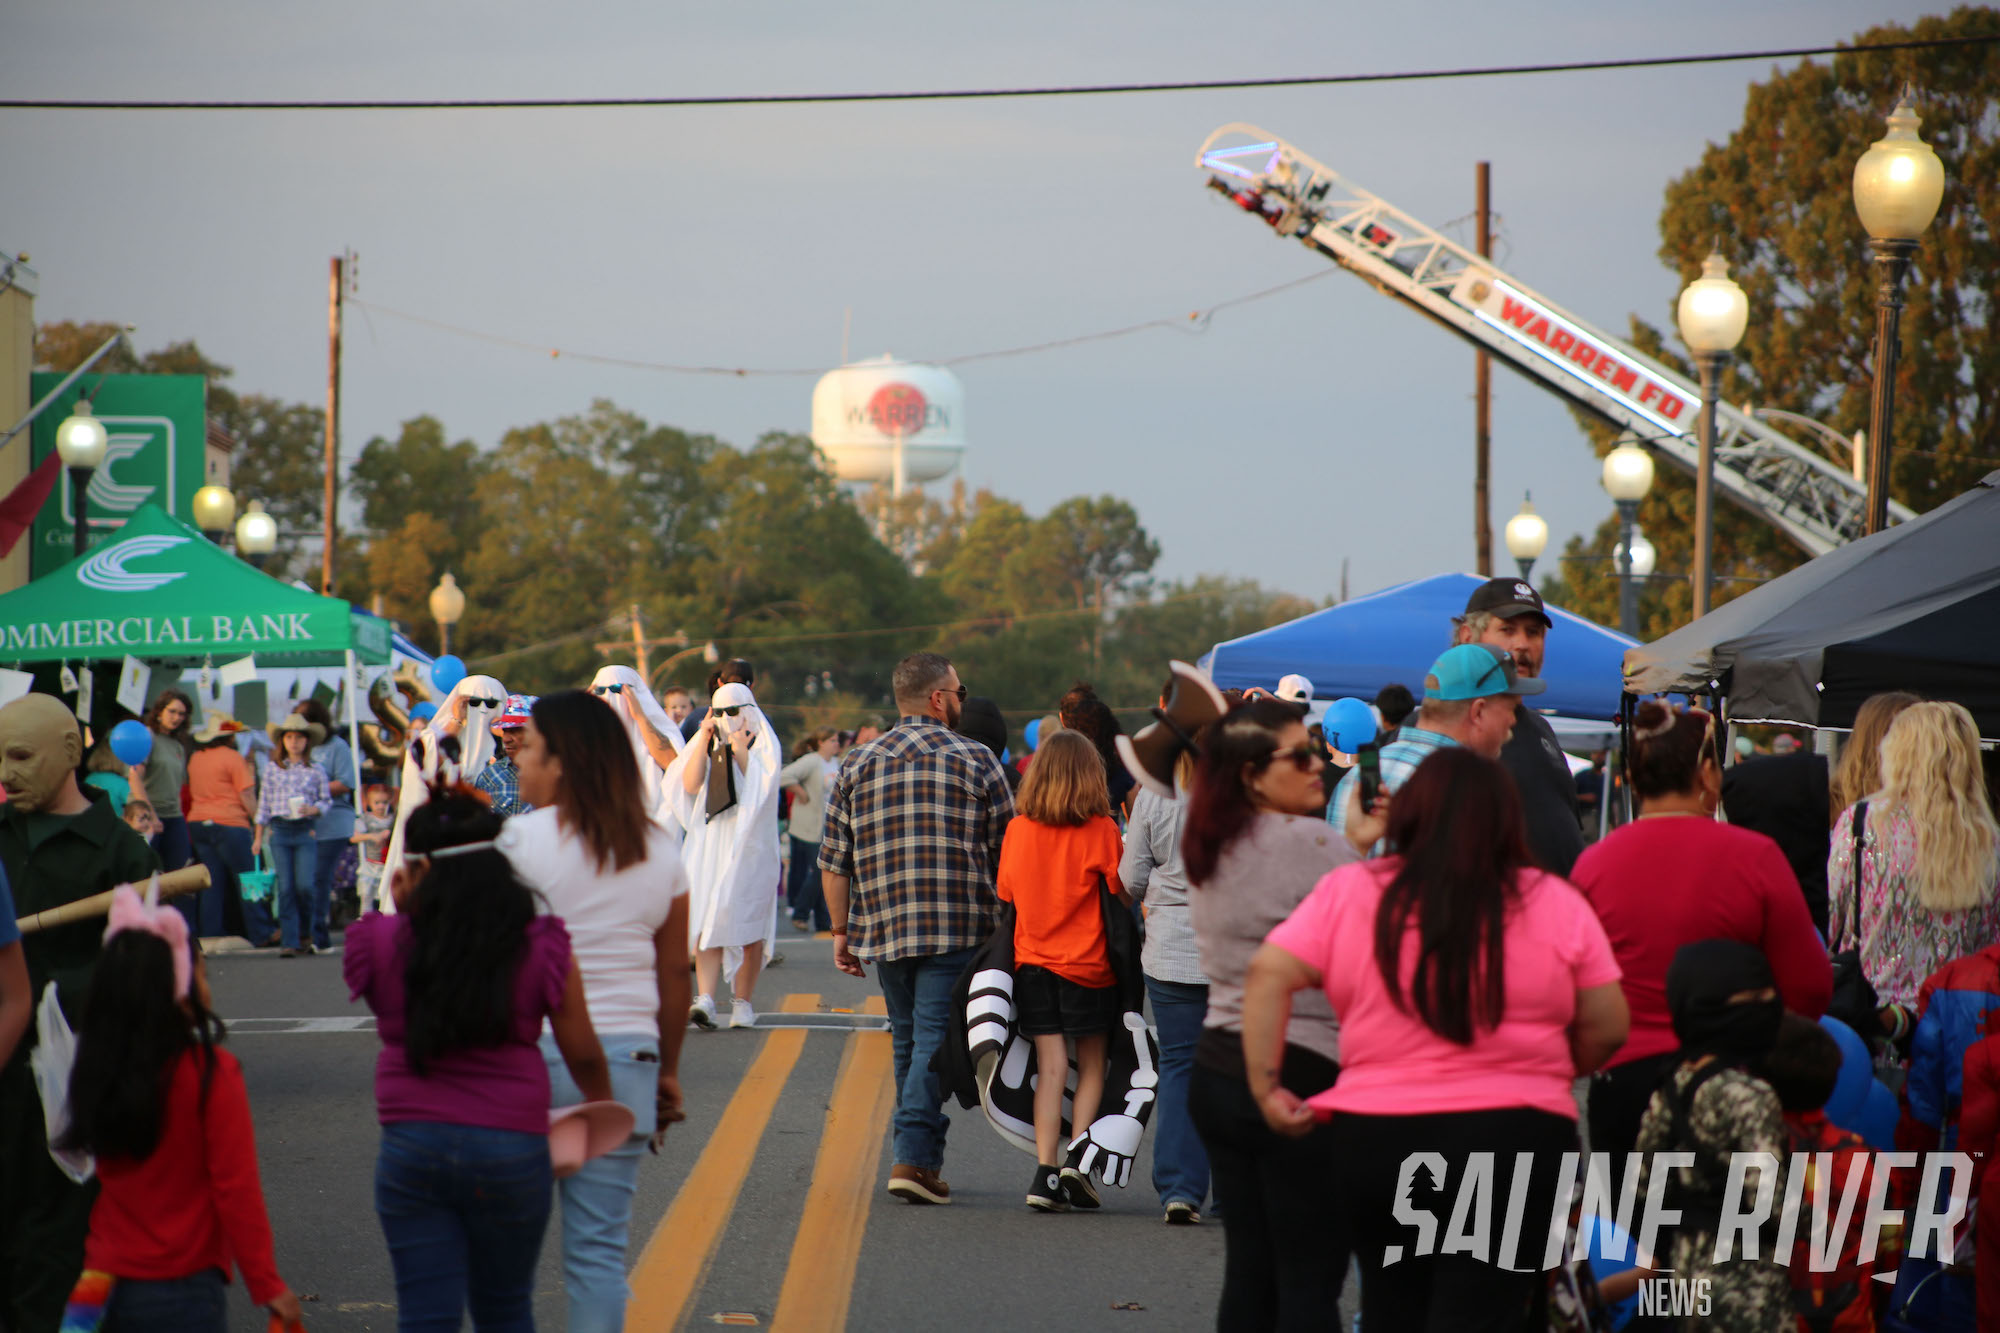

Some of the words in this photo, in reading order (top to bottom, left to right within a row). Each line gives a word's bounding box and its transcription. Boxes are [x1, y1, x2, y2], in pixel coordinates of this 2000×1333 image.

[1501, 296, 1638, 393] WARREN
[1638, 381, 1685, 420] FD
[847, 403, 952, 429] WARREN
[0, 616, 203, 650] MMERCIAL
[212, 613, 313, 642] BANK
